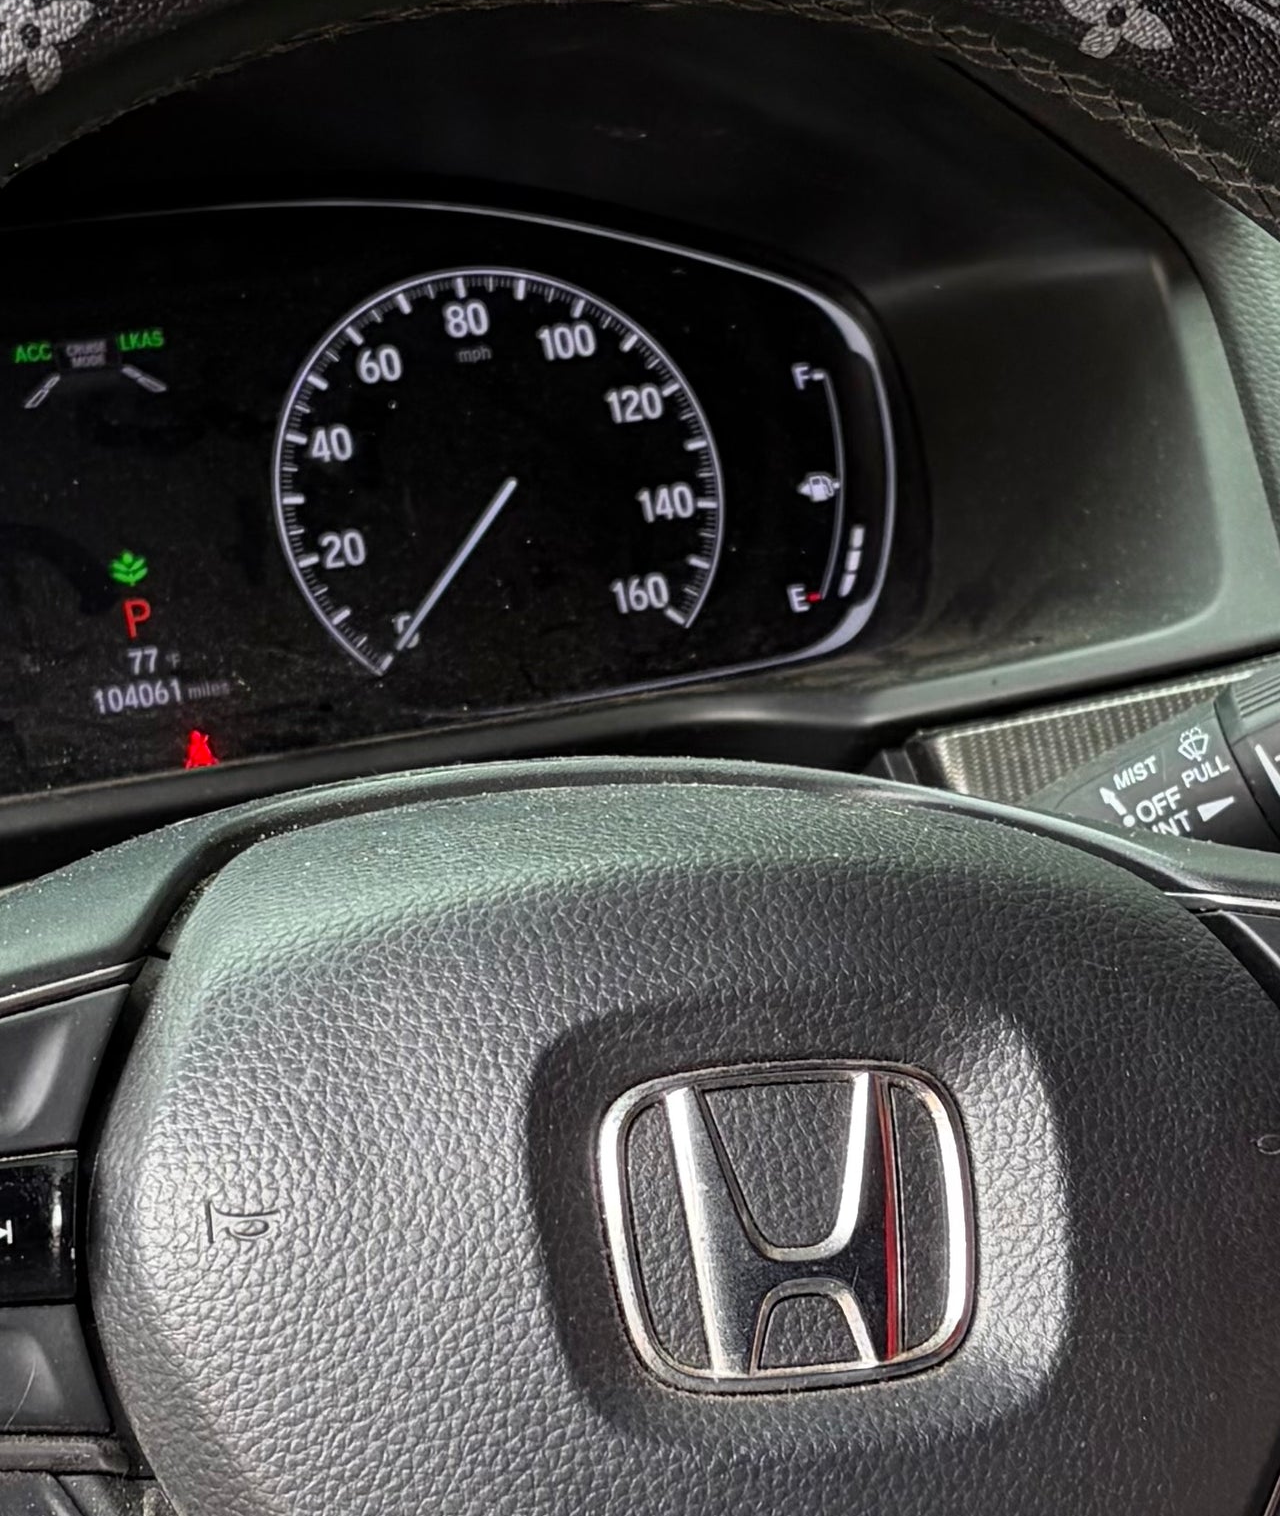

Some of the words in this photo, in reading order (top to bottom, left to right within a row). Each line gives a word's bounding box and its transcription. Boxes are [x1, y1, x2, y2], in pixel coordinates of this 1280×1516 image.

[445, 301, 489, 338] 80
[15, 342, 53, 363] ACC
[119, 329, 165, 351] LKAS
[457, 346, 492, 364] mph
[539, 322, 596, 362] 100
[357, 345, 402, 383] 60
[791, 364, 810, 389] F
[606, 385, 664, 424] 120
[310, 425, 353, 462] 40
[637, 483, 695, 522] 140
[322, 530, 366, 568] 20
[612, 573, 670, 612] 160
[787, 585, 807, 613] E
[123, 598, 151, 639] P
[128, 646, 158, 675] 77
[94, 678, 183, 715] 104061
[1113, 754, 1157, 791] MIST
[1180, 755, 1231, 789] PULL
[1135, 784, 1182, 823] OFF
